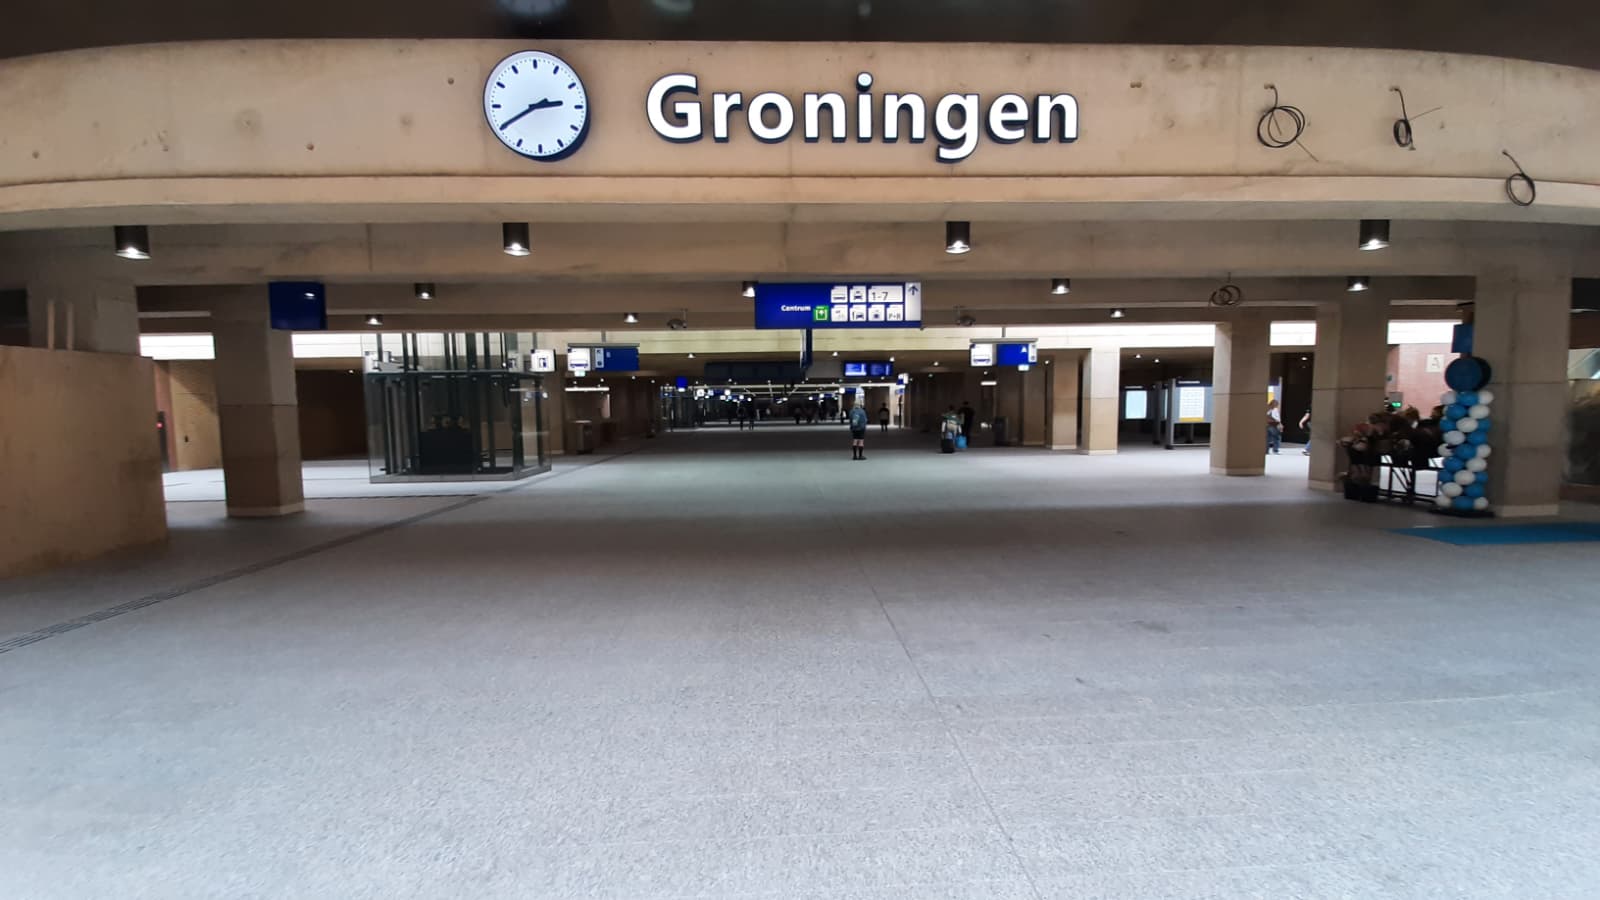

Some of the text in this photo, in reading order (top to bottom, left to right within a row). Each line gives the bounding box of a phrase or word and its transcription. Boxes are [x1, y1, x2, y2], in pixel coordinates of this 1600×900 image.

[646, 72, 1079, 162] Groningen
[872, 291, 889, 301] 1-7
[780, 304, 812, 312] Centrum
